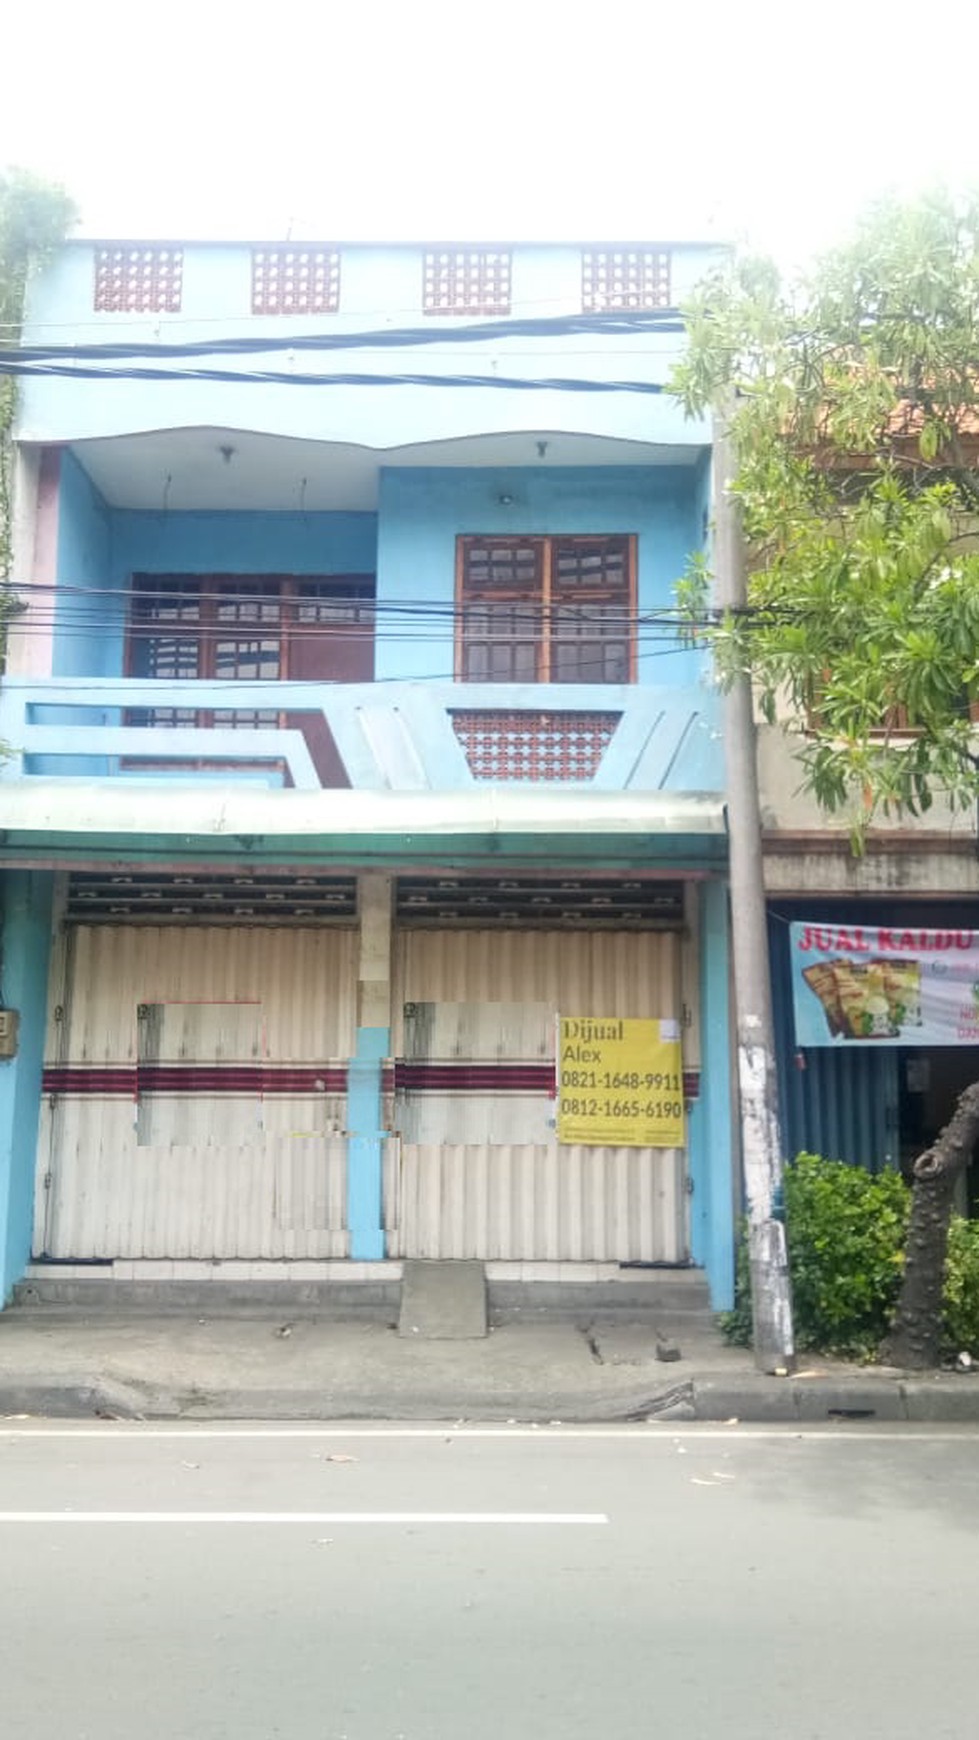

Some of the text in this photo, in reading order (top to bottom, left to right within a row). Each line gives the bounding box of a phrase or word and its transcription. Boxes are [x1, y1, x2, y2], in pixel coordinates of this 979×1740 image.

[799, 927, 869, 951] JUAL
[563, 1019, 624, 1043] Dijual
[563, 1045, 602, 1063] Alex
[561, 1070, 680, 1091] 0821-1648-9911
[561, 1099, 682, 1118] 0812-1665-6190
